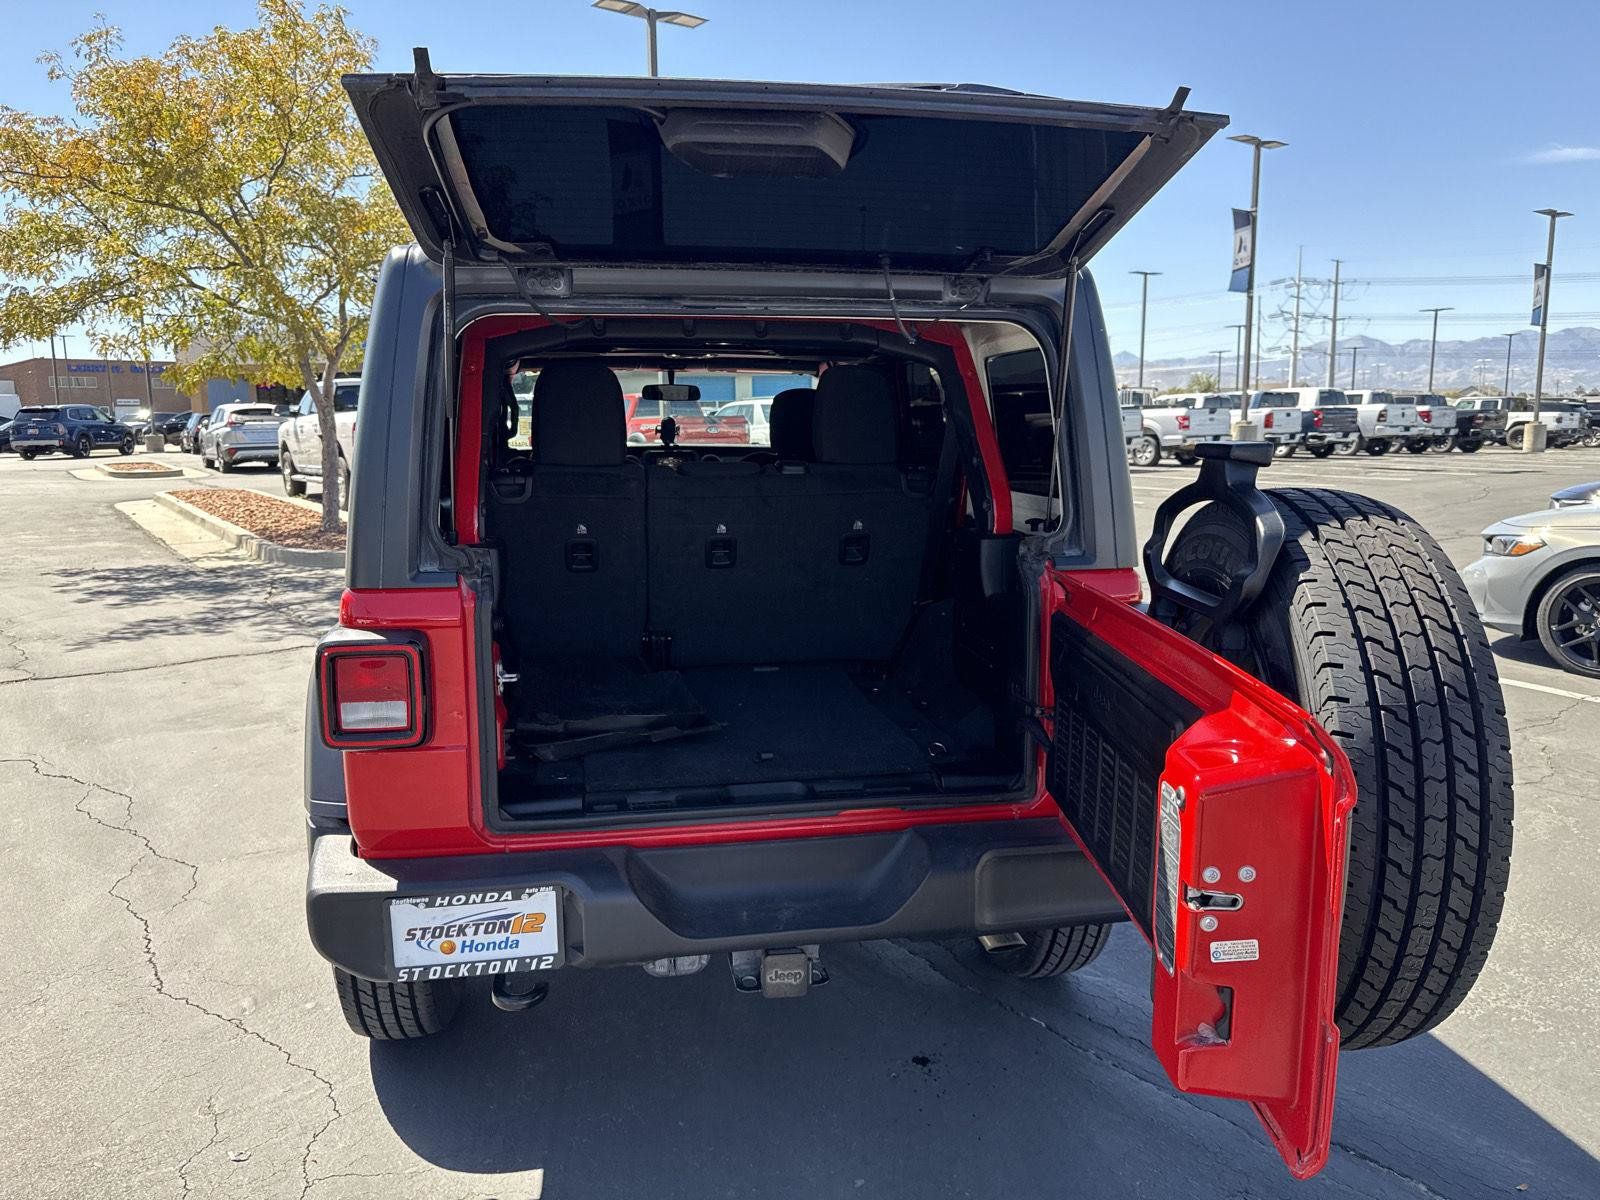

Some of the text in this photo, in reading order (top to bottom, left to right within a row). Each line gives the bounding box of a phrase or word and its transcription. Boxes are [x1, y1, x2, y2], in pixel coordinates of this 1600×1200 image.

[434, 890, 513, 907] HONDA
[460, 936, 520, 954] Honda
[397, 958, 517, 982] STOCKTON
[768, 969, 803, 983] Jeep
